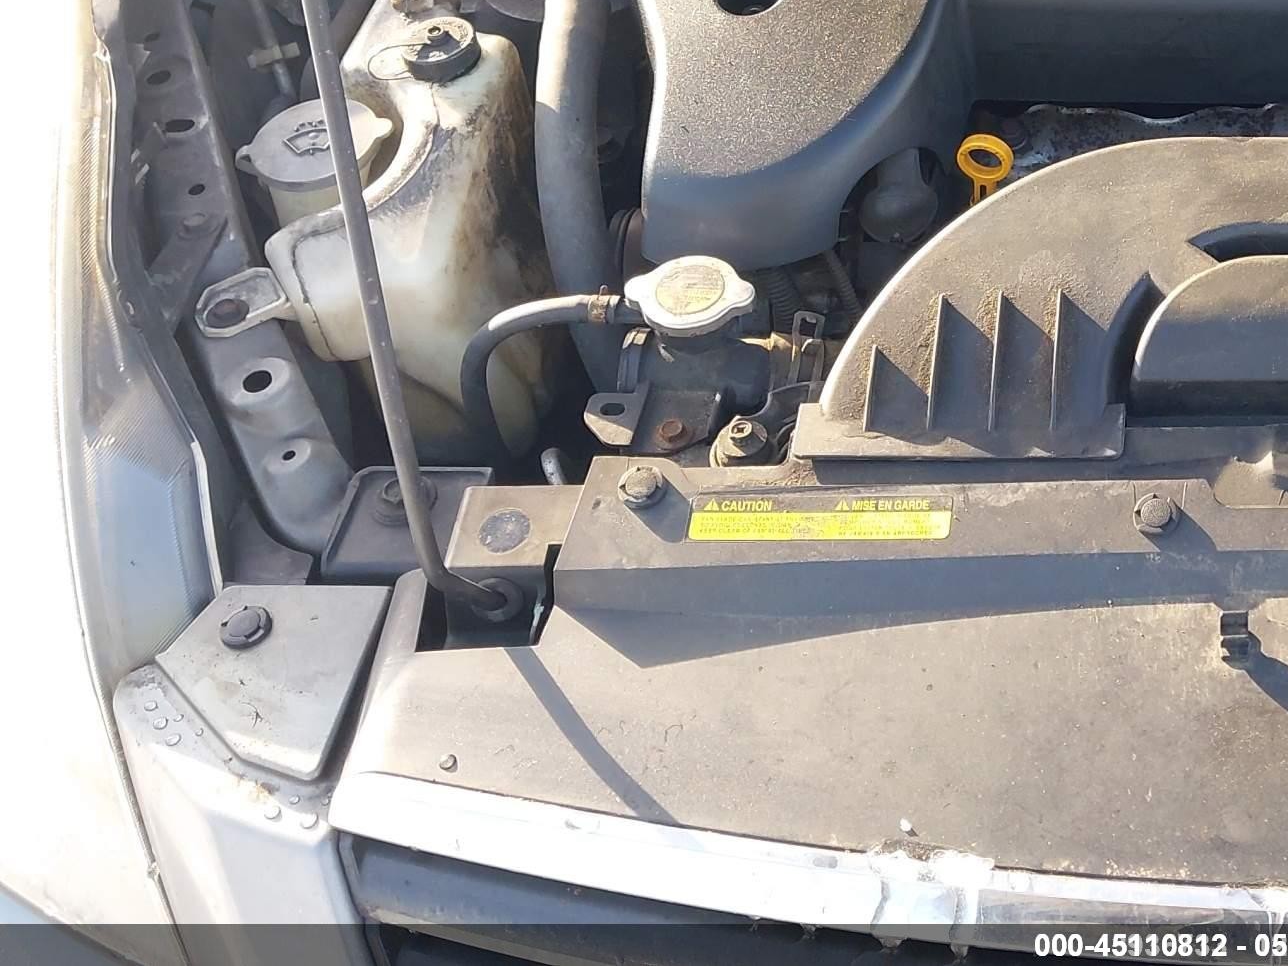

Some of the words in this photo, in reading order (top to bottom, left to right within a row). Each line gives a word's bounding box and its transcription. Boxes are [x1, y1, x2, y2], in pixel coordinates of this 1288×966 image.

[721, 499, 772, 512] CAUTION
[852, 499, 877, 511] MISE
[878, 499, 893, 511] EN
[893, 499, 931, 511] GARDE
